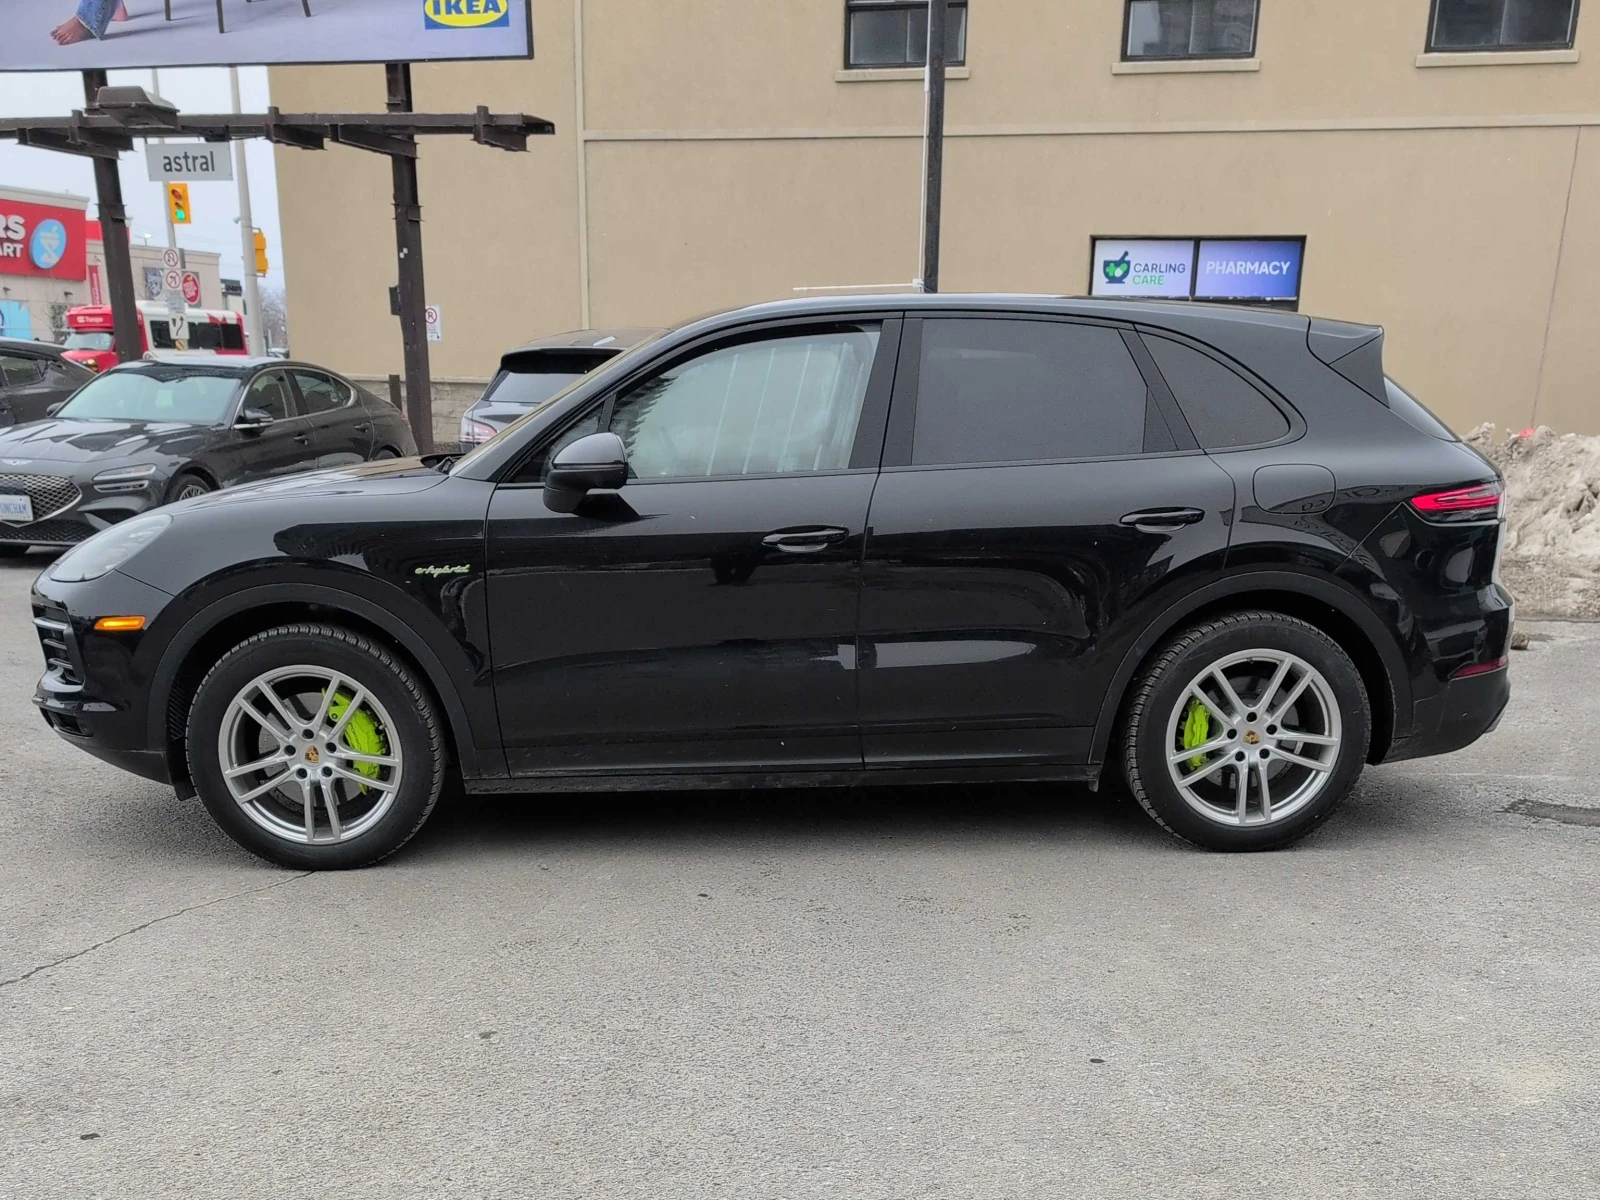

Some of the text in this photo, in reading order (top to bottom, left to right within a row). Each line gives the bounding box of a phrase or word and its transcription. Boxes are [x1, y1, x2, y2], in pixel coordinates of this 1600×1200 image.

[433, 0, 501, 15] IKEA
[163, 151, 215, 173] astral
[1133, 262, 1186, 274] CARLING
[1205, 261, 1291, 275] PHARMACY
[1132, 275, 1164, 285] CARE
